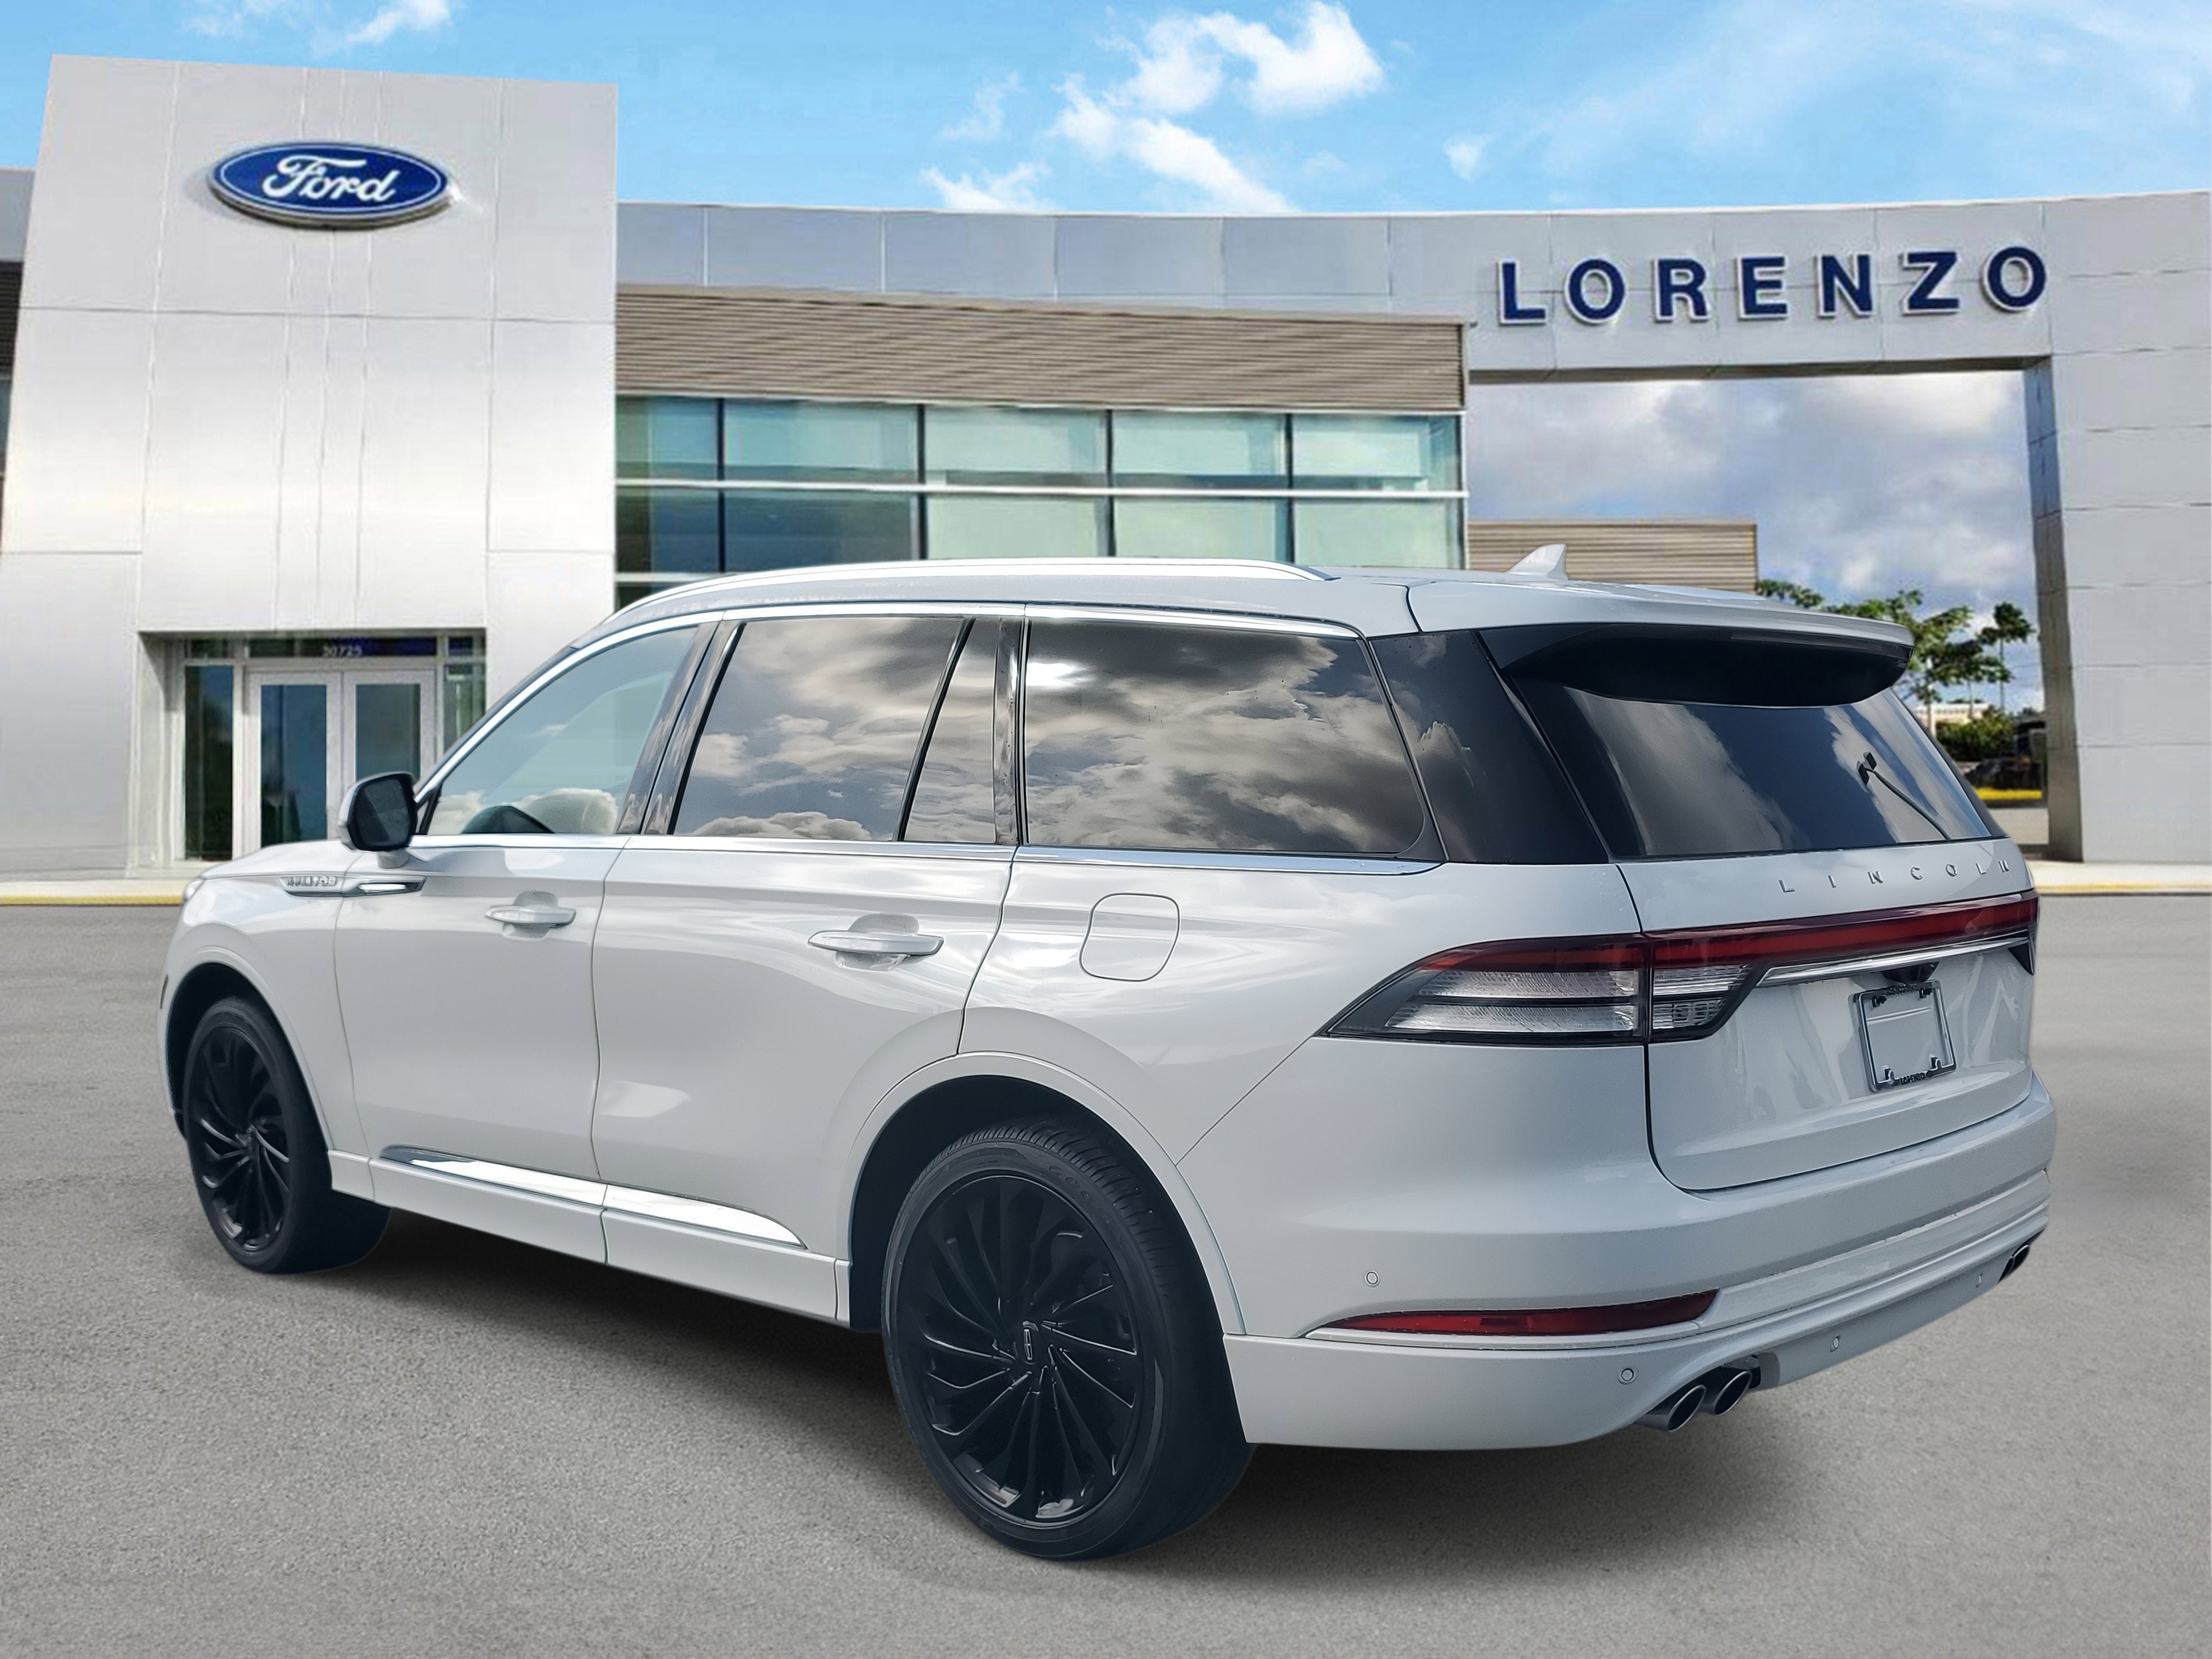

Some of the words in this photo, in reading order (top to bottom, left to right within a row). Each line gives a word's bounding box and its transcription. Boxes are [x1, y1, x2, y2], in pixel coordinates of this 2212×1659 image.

[262, 155, 402, 203] Ford
[1499, 247, 2047, 325] LORENZO
[1778, 859, 2009, 893] LINCOLN
